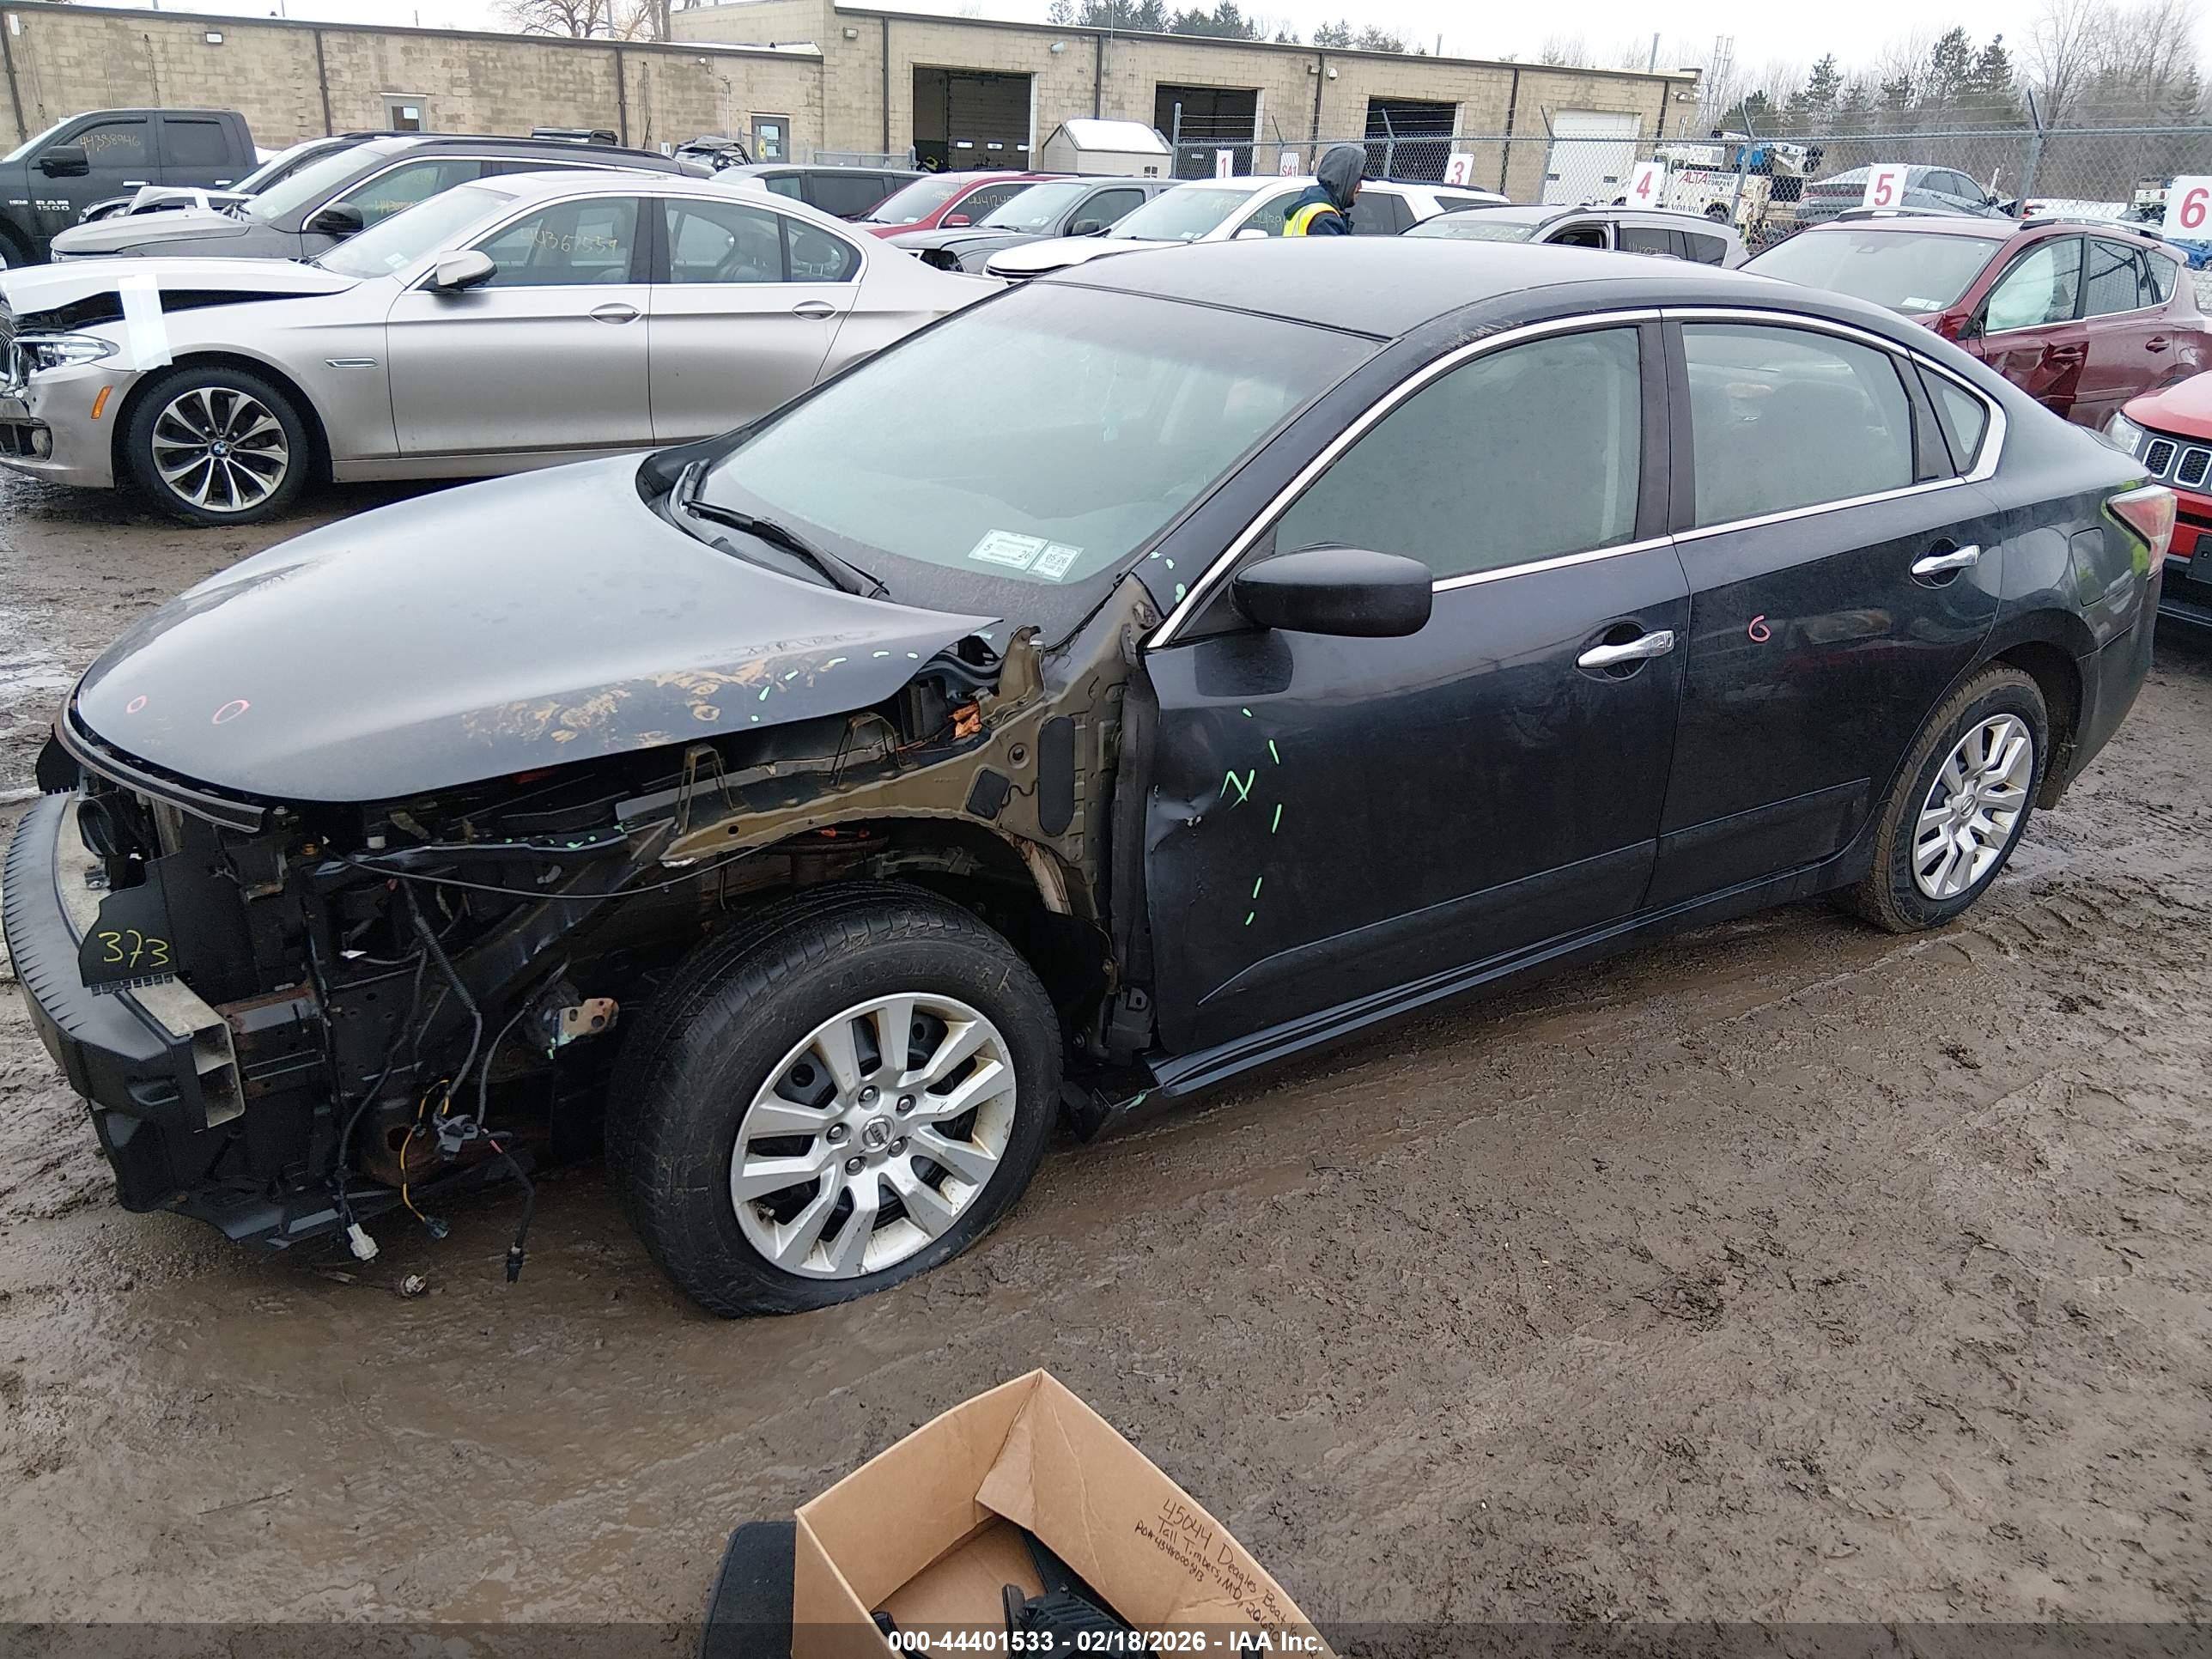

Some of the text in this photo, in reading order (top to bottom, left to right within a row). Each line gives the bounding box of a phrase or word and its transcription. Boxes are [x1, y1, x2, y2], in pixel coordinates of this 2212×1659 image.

[1221, 157, 1227, 178] 1
[1450, 161, 1465, 185] 3
[1678, 171, 1709, 185] ALTA
[1636, 171, 1653, 199] 4
[1874, 173, 1895, 206] 5
[1669, 203, 1699, 214] VOLVO
[2179, 187, 2209, 229] 6
[98, 929, 169, 969] 373
[1158, 1515, 1178, 1543] Tall
[1163, 1498, 1213, 1551] 45044
